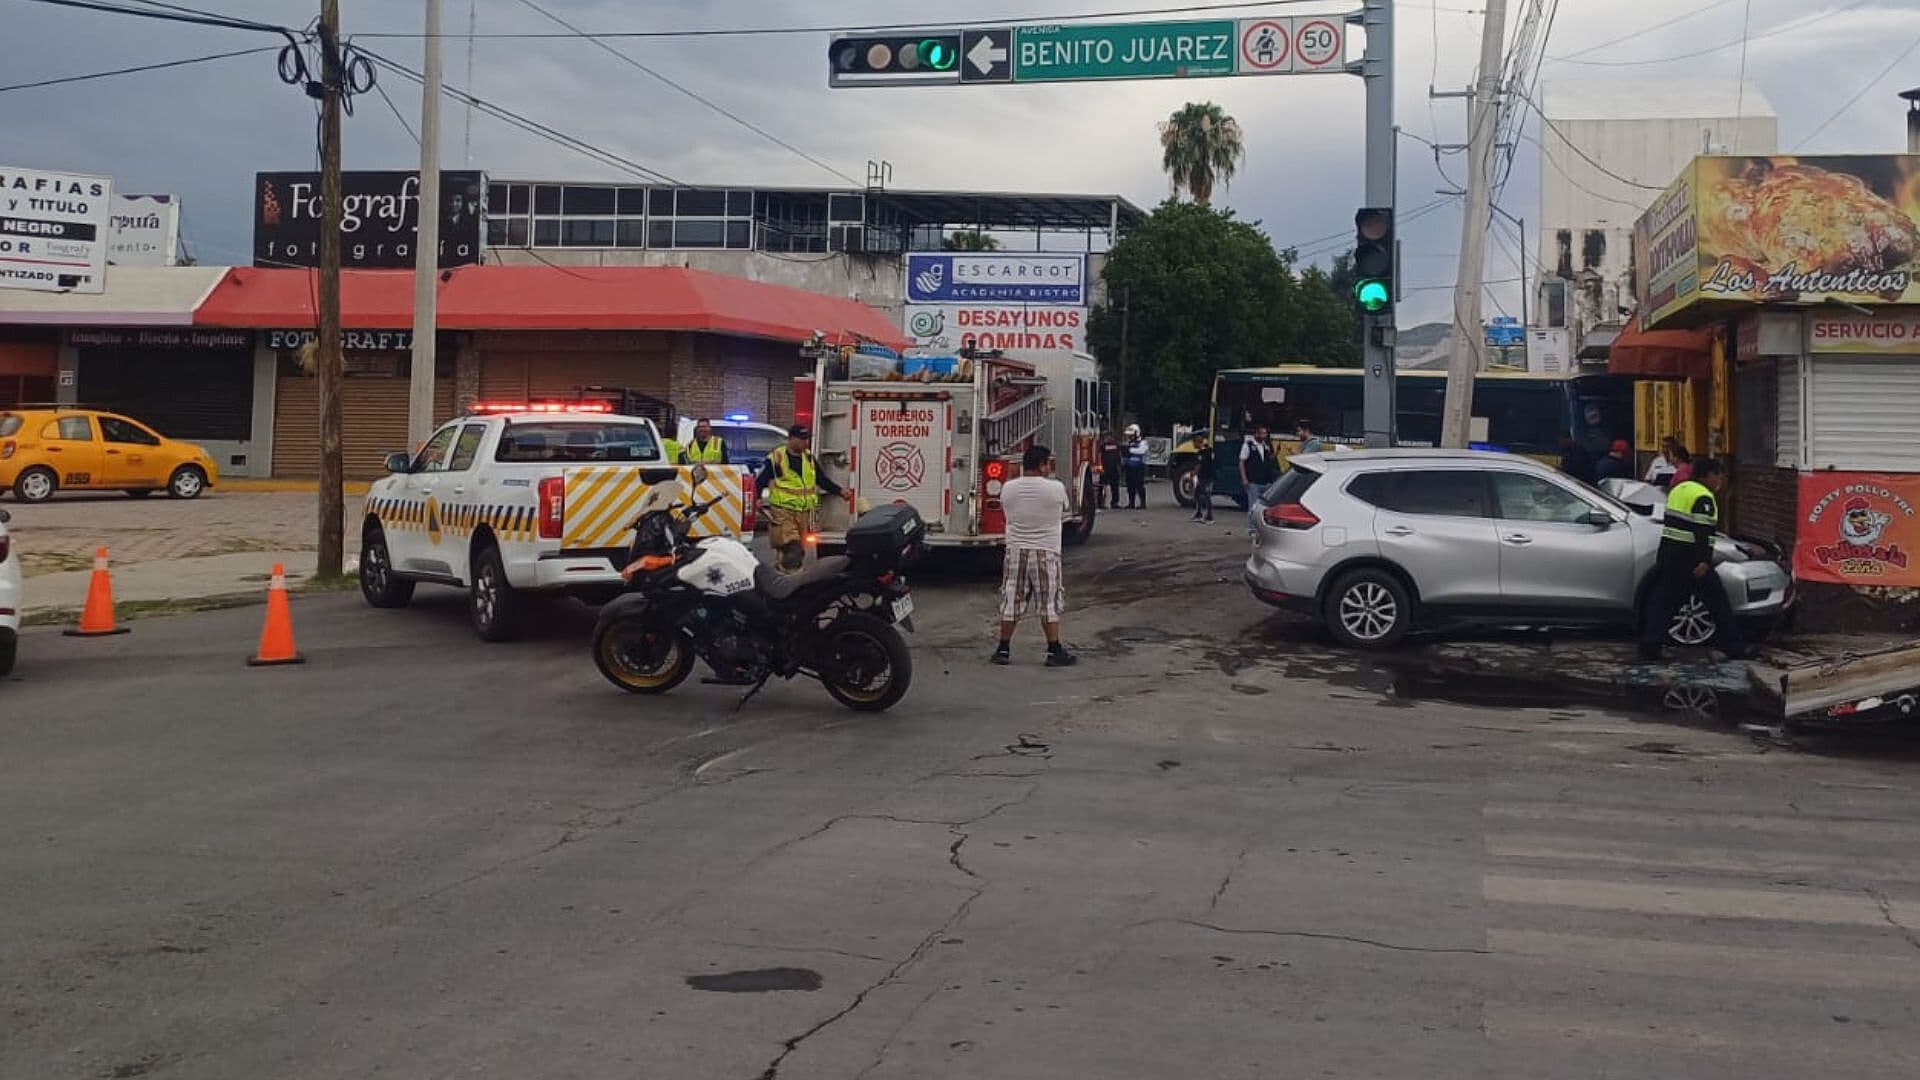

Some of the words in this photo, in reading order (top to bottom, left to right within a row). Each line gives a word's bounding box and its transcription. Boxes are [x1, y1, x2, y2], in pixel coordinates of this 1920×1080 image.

[1303, 29, 1333, 49] 50
[1021, 39, 1114, 67] BENITO
[1121, 34, 1229, 64] JUAREZ
[9, 201, 18, 211] y
[29, 198, 89, 214] TITULO
[3, 219, 65, 236] NEGRO
[957, 264, 1073, 278] ESCARGOT
[1701, 262, 1754, 292] Los
[1764, 262, 1907, 292] Autenticos
[951, 288, 1022, 298] ACADEMIA
[1029, 288, 1080, 298] BISTRO
[957, 309, 1080, 328] DESAYUNOS
[1815, 322, 1906, 339] SERVICIO
[960, 331, 1074, 349] COMIDAS
[870, 408, 935, 423] BOMBEROS
[874, 425, 930, 438] TORREON
[1846, 485, 1889, 496] POLLO
